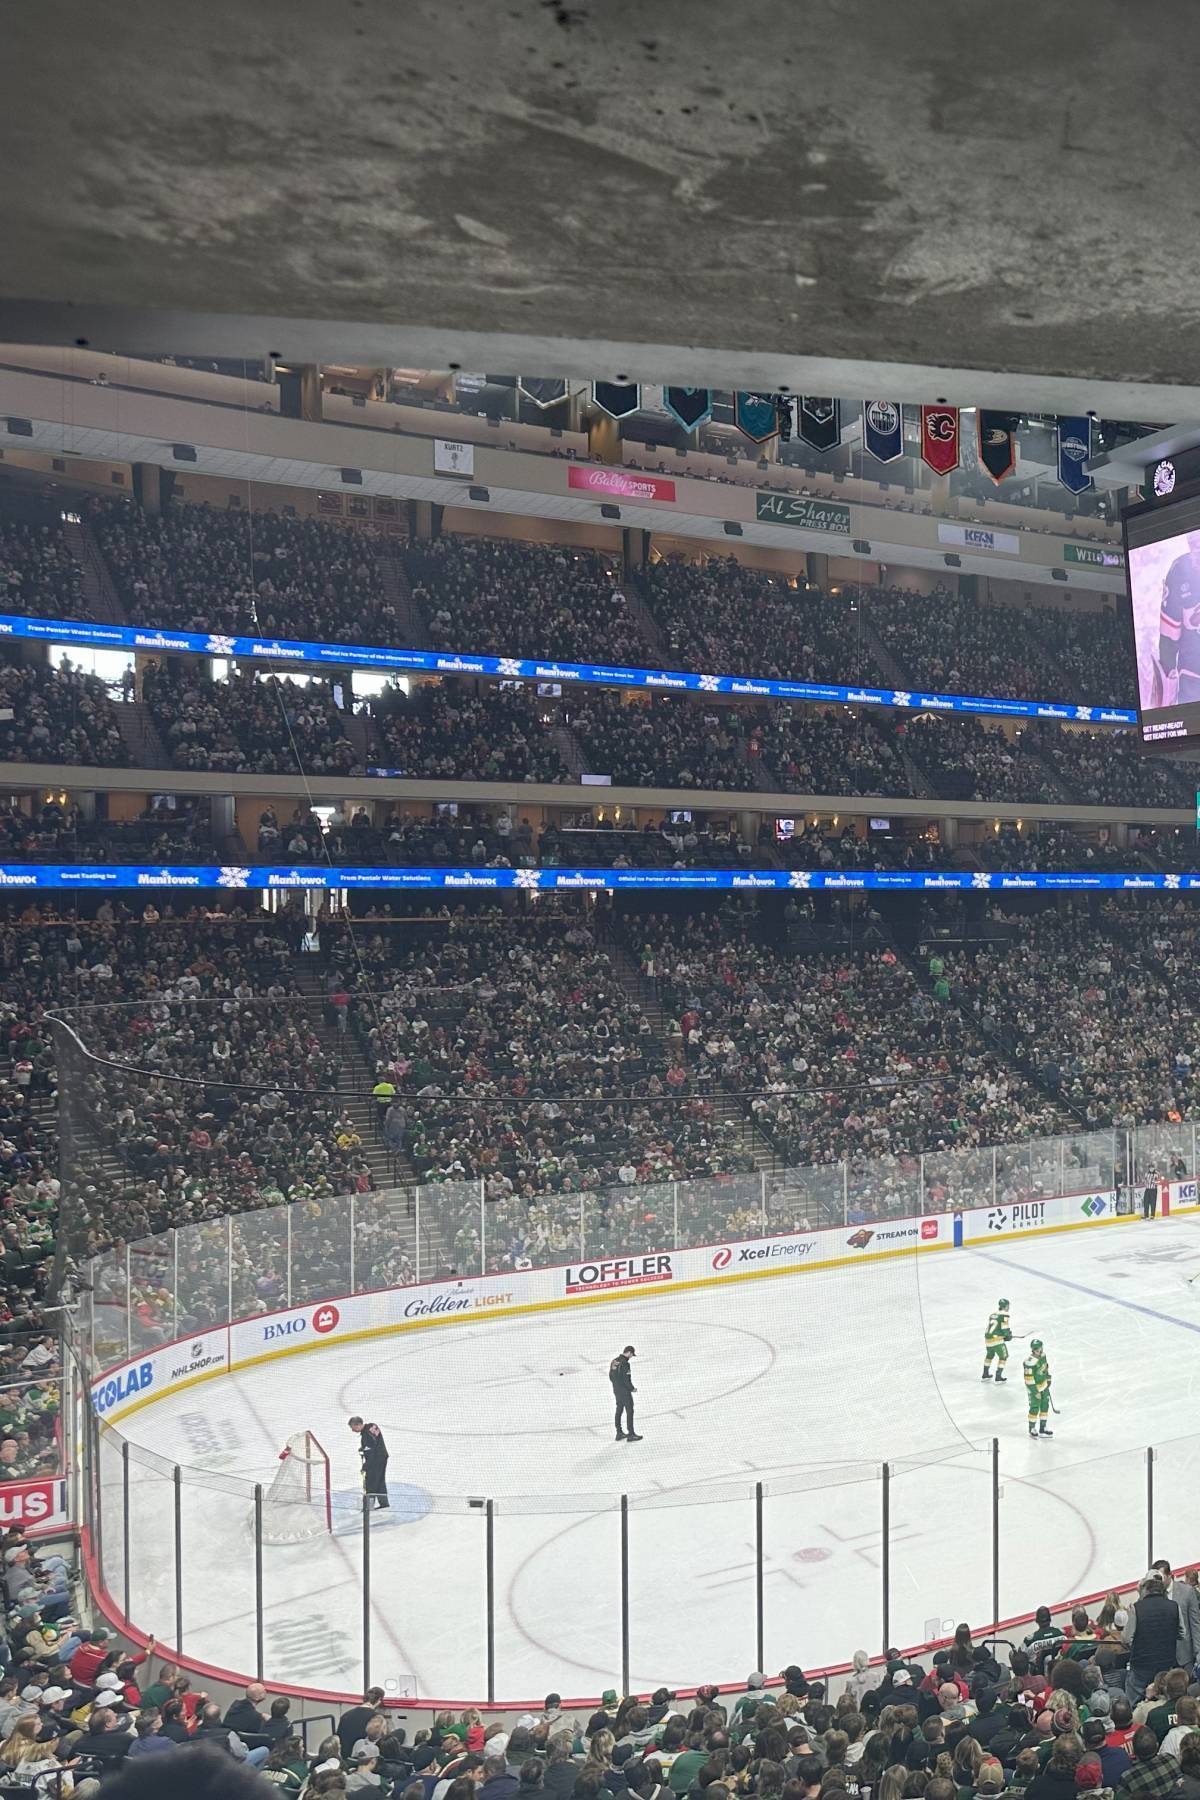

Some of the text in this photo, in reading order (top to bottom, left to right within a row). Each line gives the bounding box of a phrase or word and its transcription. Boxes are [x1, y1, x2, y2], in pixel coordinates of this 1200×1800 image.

[589, 470, 656, 493] Bally SPORTS
[785, 497, 850, 524] Shaver
[800, 518, 849, 533] PRESS BOX
[135, 635, 190, 648] Manitowoc
[253, 644, 304, 657] Manitowoc
[437, 659, 483, 671] Manitowoc
[138, 874, 199, 884] Manitowoc
[269, 875, 326, 885] Manitowoc
[445, 875, 496, 885] Manitowoc
[557, 876, 605, 886] Manitowoc
[733, 877, 776, 886] Manitowoc
[825, 877, 864, 886] Manitowoc
[1012, 1202, 1045, 1221] PILOT
[876, 1230, 905, 1240] STREAM
[907, 1229, 918, 1237] ON
[566, 1255, 672, 1286] LOFFLER
[404, 1293, 513, 1318] Golden LIGHT
[263, 1318, 306, 1341] BMO
[171, 1354, 225, 1379] NHLSHOP.com
